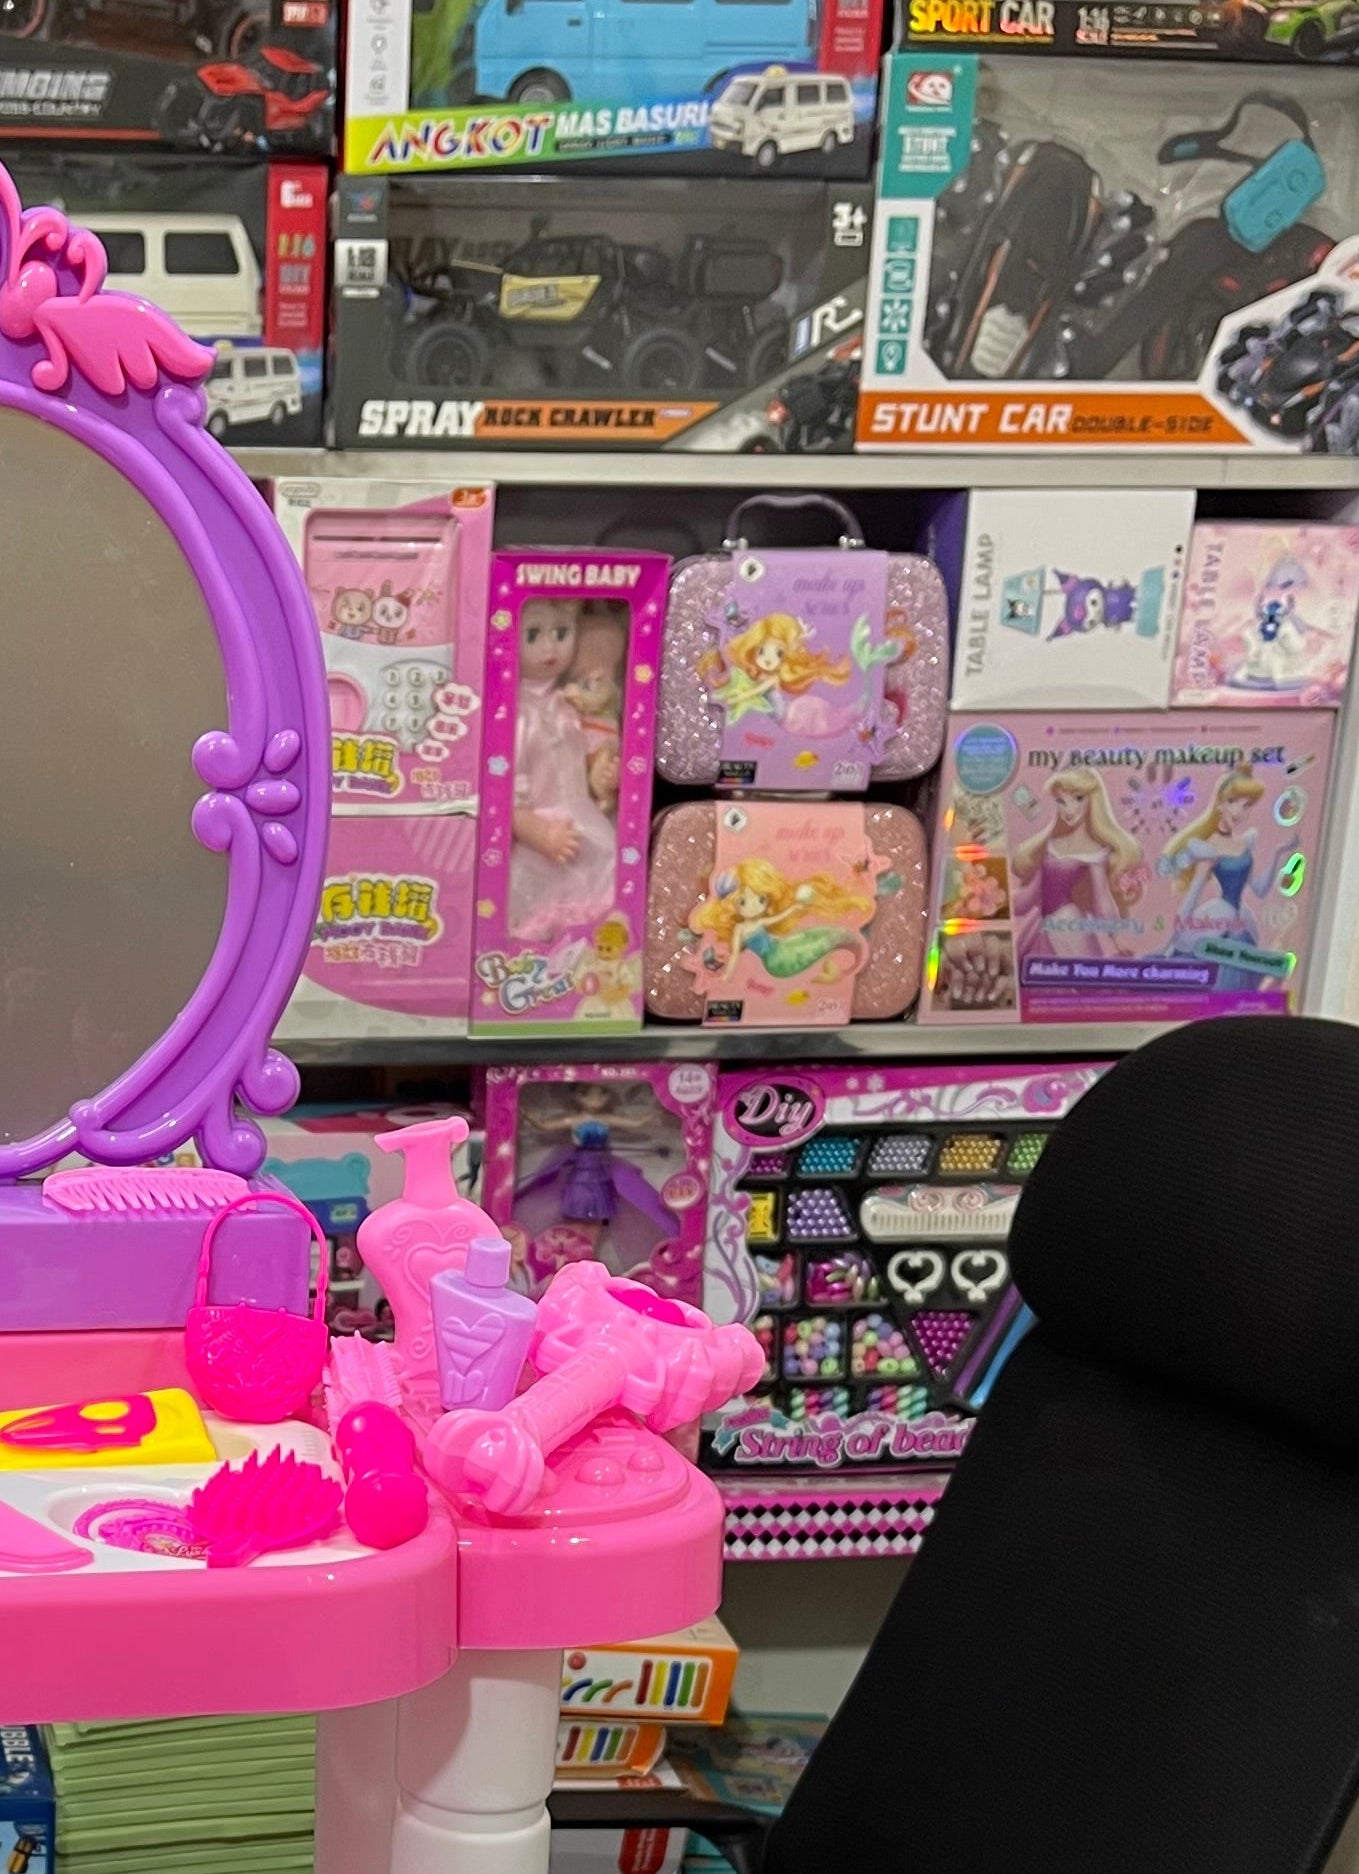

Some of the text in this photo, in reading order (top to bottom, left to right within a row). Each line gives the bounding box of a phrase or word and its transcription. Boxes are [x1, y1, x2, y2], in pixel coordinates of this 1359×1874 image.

[909, 0, 1054, 36] SPORT CAR
[368, 113, 555, 166] ANGKOT
[556, 110, 612, 138] MAS
[358, 400, 655, 437] SPRAY ROCK CRAWLER
[871, 402, 989, 434] STUNT
[998, 402, 1073, 434] CAR
[516, 563, 640, 587] SWING BABY
[964, 533, 995, 678] TABLE LAMP
[1028, 751, 1064, 771] my
[1251, 745, 1286, 766] set
[739, 1083, 817, 1137] Diy
[741, 1428, 843, 1464] String
[847, 1423, 890, 1454] of
